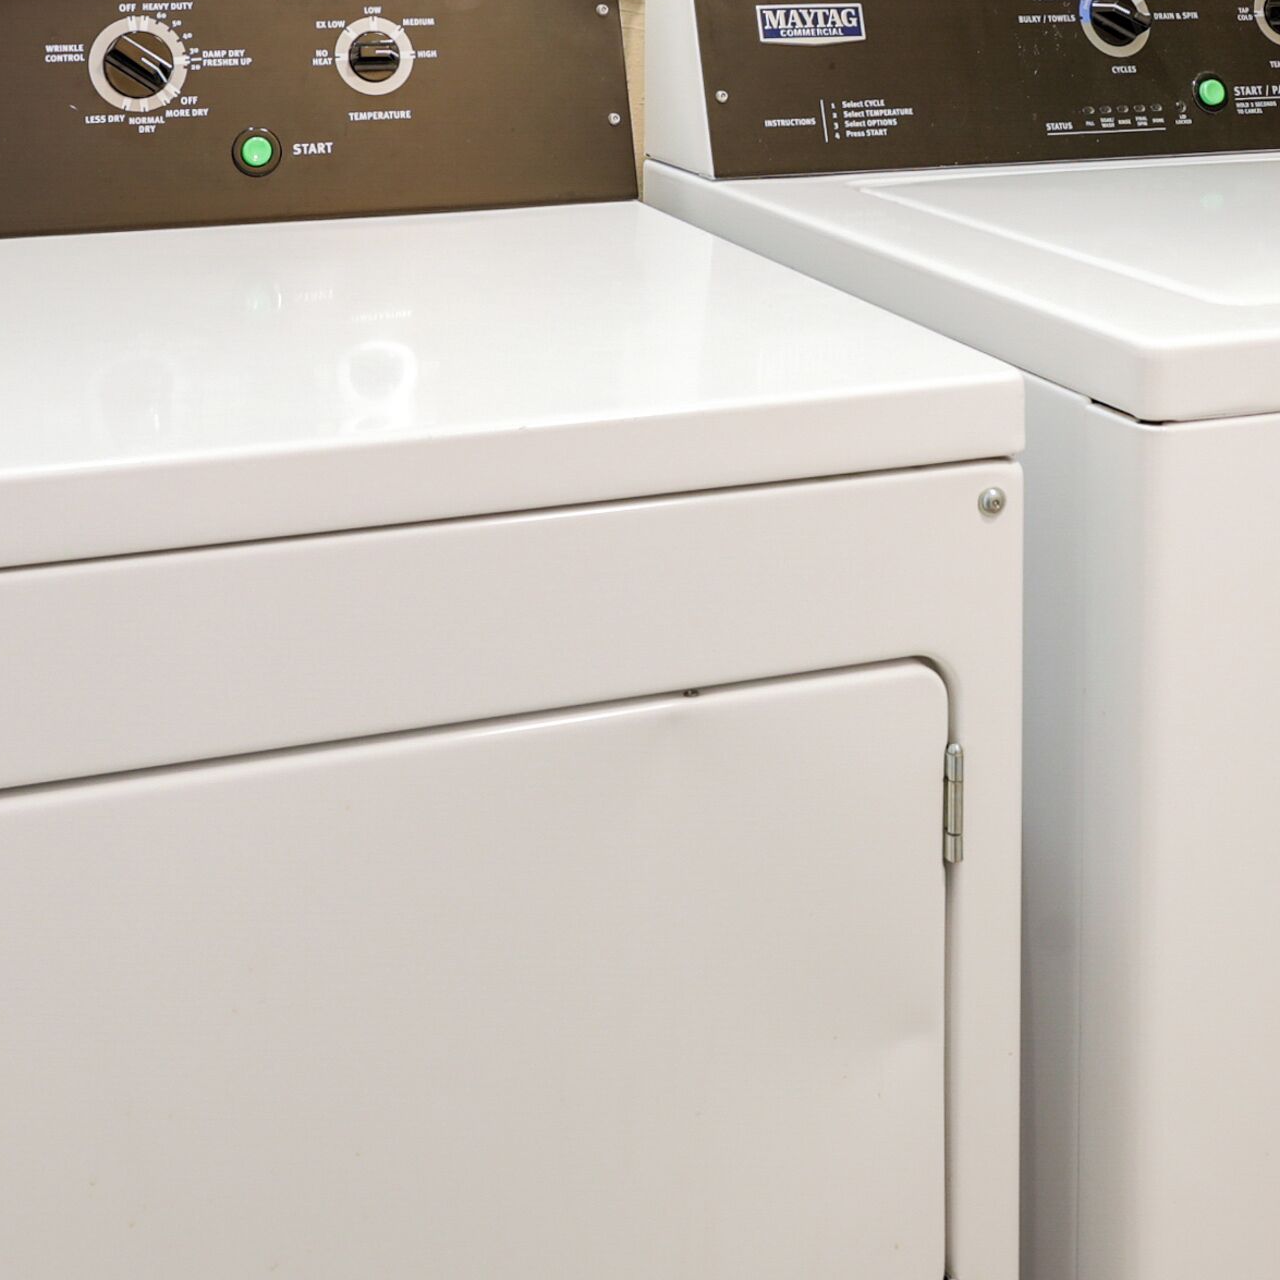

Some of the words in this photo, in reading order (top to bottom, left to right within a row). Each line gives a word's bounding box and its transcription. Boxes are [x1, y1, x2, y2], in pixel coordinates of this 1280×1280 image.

[119, 4, 136, 13] OFF
[142, 3, 169, 11] HEAVY
[170, 1, 193, 10] DUTY
[364, 6, 382, 15] LOW
[762, 8, 859, 30] MAYTAG
[1018, 15, 1042, 24] BULKY
[1048, 13, 1076, 22] TOWELS
[1153, 12, 1174, 20] DRAIN
[1181, 11, 1198, 19] SPIN
[172, 20, 182, 28] 50
[316, 21, 328, 29] EX
[329, 20, 346, 28] LOW
[402, 18, 435, 26] MEDIUM
[780, 26, 844, 37] COMMERCIAL
[45, 44, 84, 53] WRINKLE
[202, 50, 227, 58] DAMP
[229, 49, 245, 57] DRY
[45, 54, 85, 62] CONTROL
[417, 50, 437, 58] HIGH
[203, 58, 239, 66] FRESHEN
[240, 58, 252, 66] UP
[1111, 66, 1136, 74] CYCLES
[1233, 86, 1263, 96] START
[181, 96, 198, 105] OFF
[842, 100, 864, 109] Select
[864, 99, 885, 107] CYCLE
[165, 109, 190, 118] MORE
[192, 108, 209, 117] DRY
[349, 110, 411, 121] TEMPERATURE
[843, 109, 865, 118] Select
[866, 107, 913, 117] TEMPERATURE
[85, 115, 107, 124] LESS
[108, 114, 125, 123] DRY
[129, 116, 165, 125] NORMAL
[764, 117, 816, 127] INSTRUCTIONS
[844, 119, 866, 128] Select
[867, 118, 897, 127] OPTIONS
[138, 125, 156, 133] DRY
[1046, 121, 1073, 131] STATUS
[845, 130, 865, 138] Press
[866, 128, 887, 137] START
[292, 142, 334, 155] START
